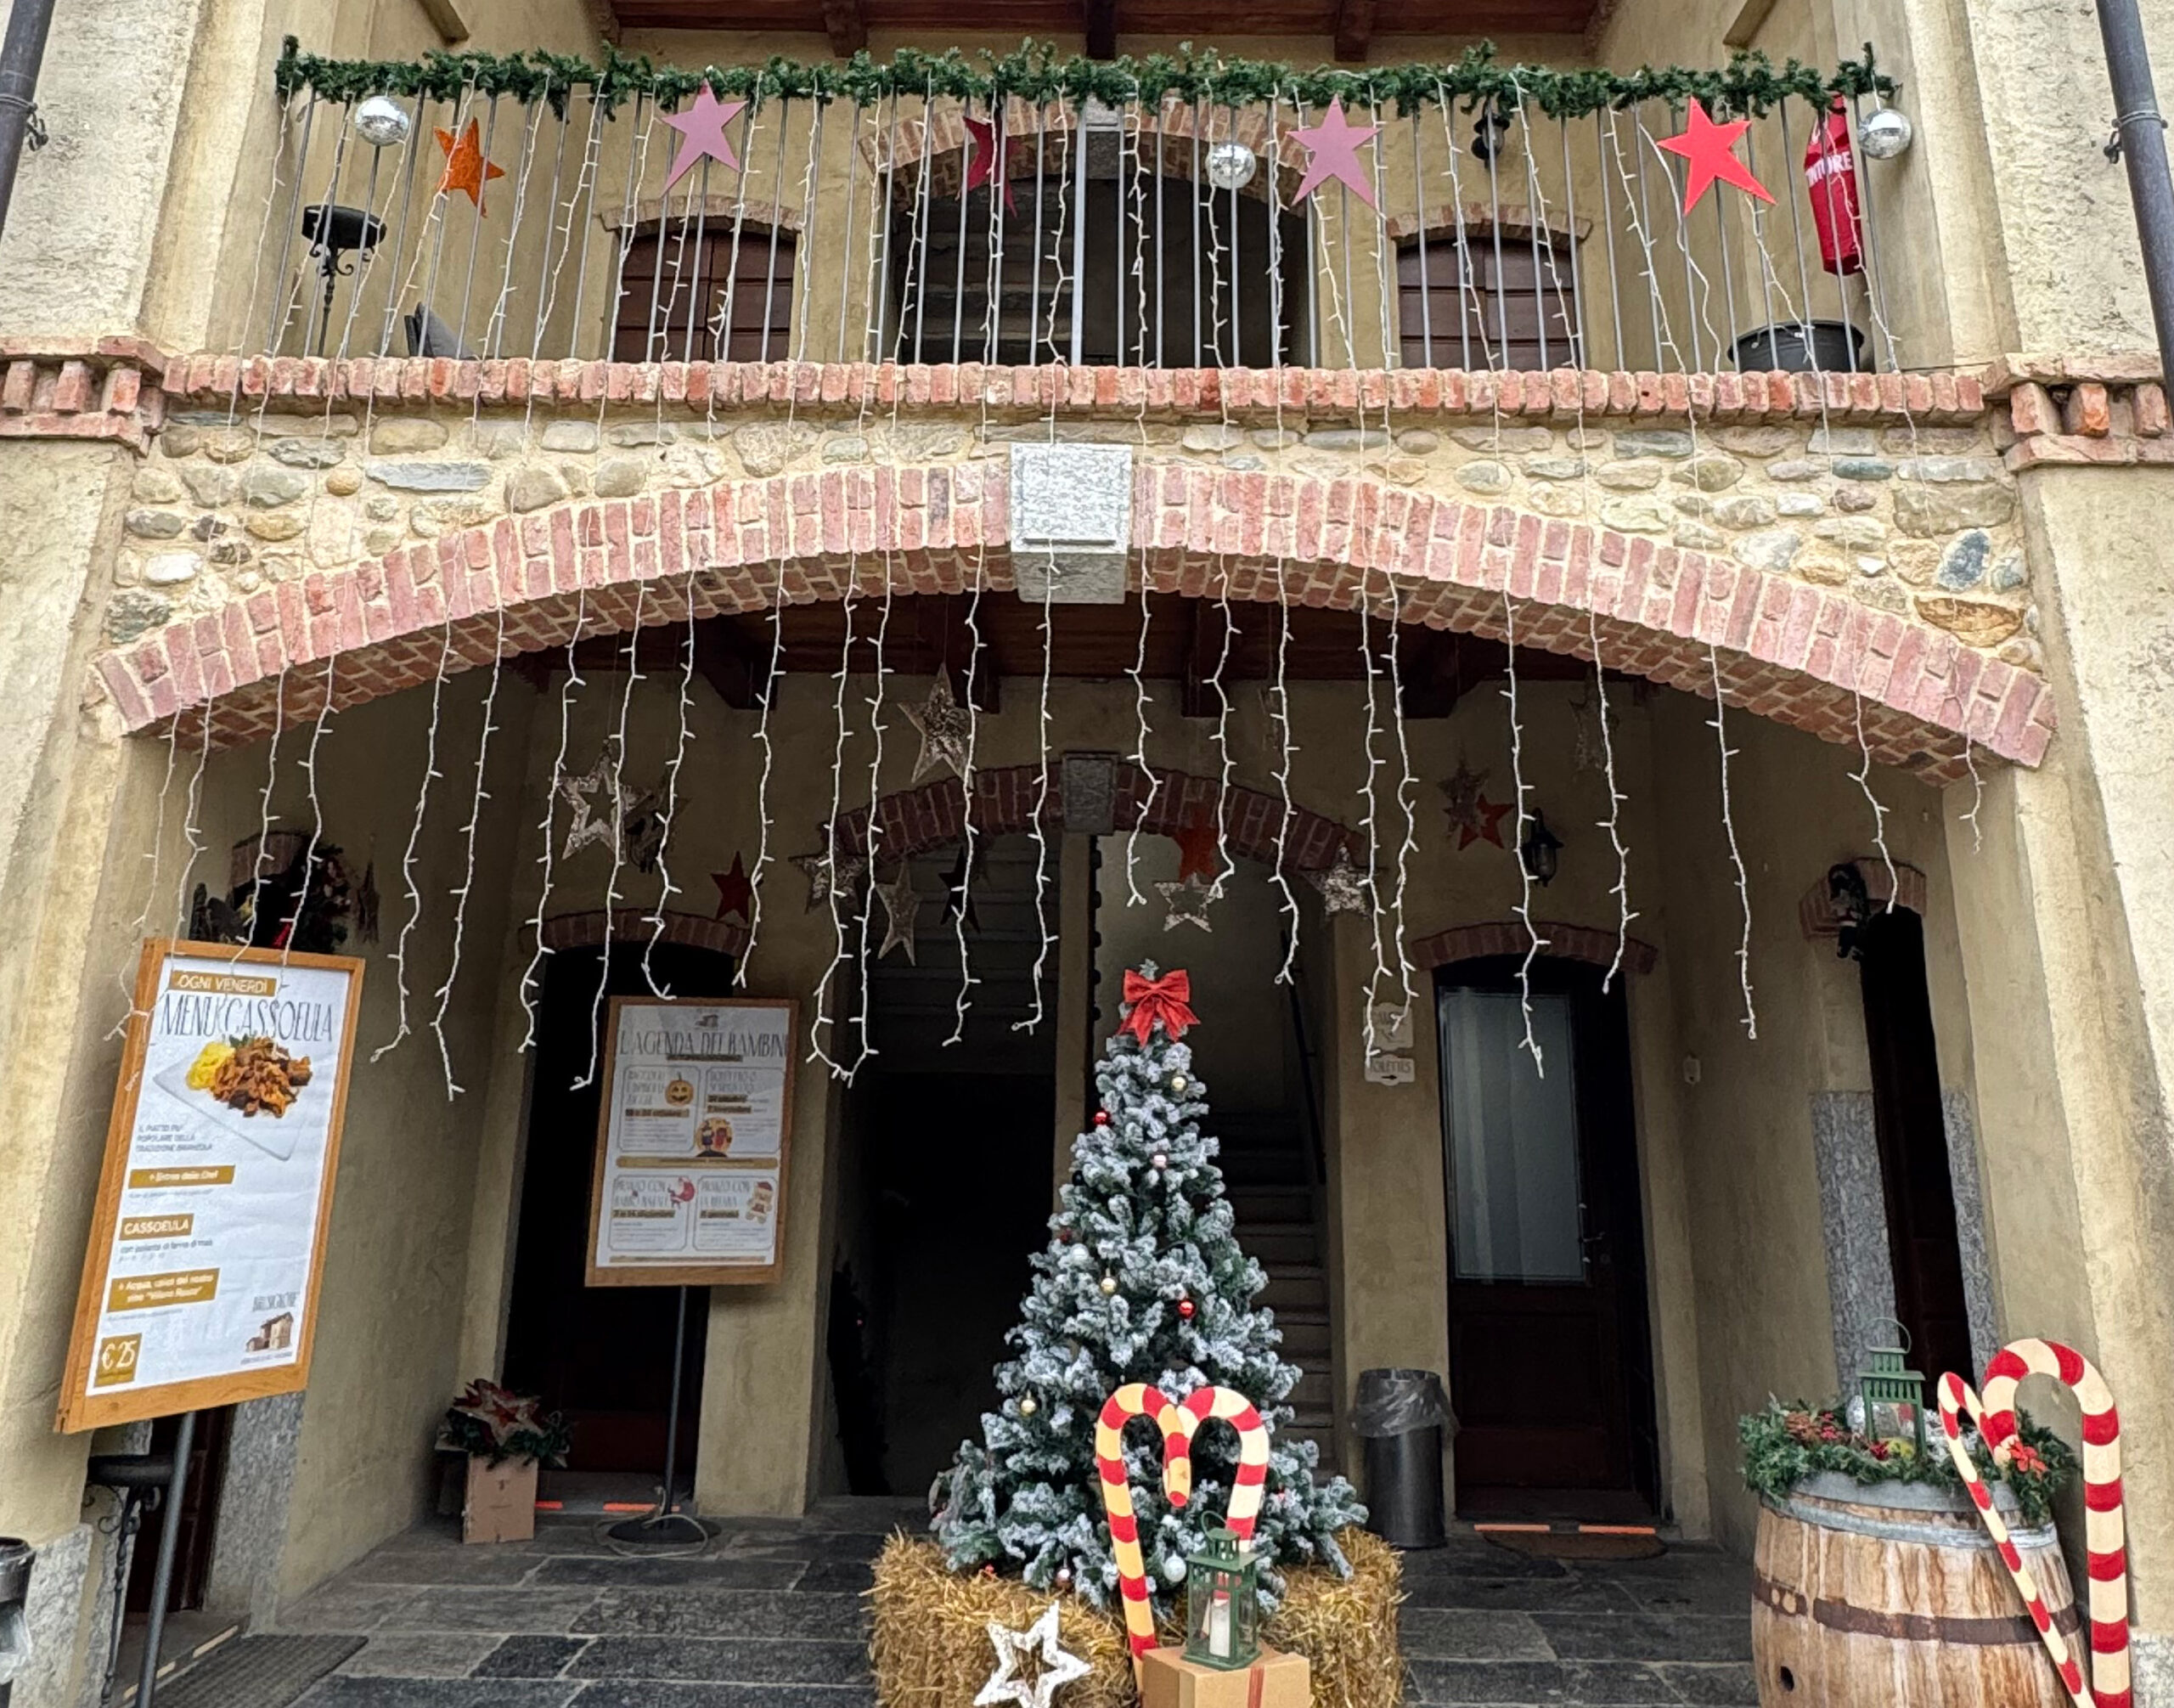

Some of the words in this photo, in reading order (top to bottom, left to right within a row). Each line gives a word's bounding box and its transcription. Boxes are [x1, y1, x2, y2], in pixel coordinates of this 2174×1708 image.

[177, 974, 212, 990] OGNI
[224, 997, 333, 1042] CASSOEULA
[123, 1219, 189, 1236] CASSOEULA
[115, 1339, 138, 1369] 25
